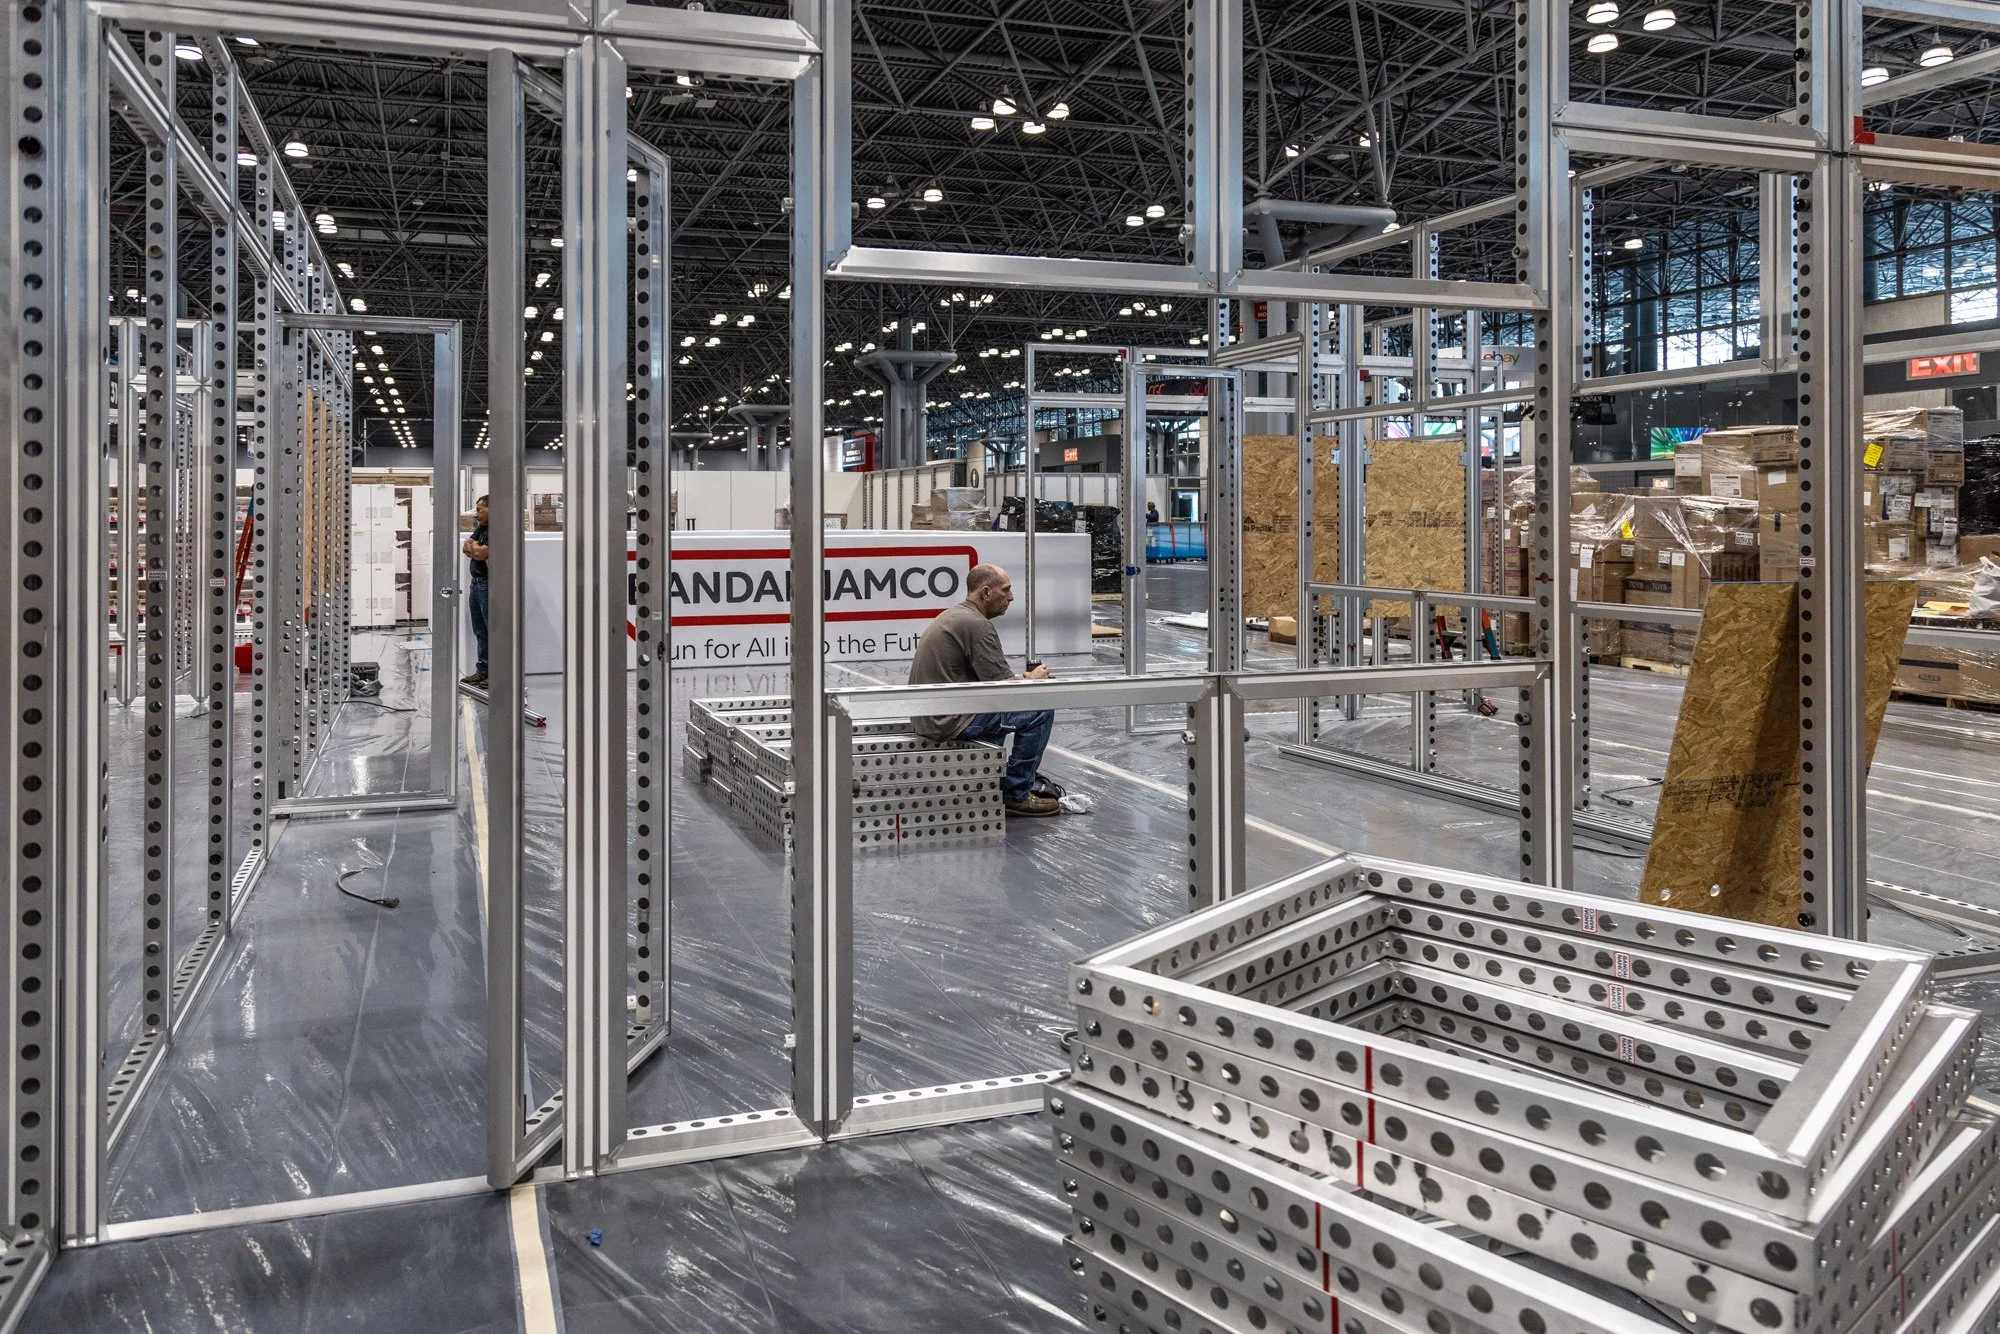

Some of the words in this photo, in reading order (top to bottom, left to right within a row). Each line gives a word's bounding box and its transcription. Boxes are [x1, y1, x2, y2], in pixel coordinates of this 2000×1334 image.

[629, 570, 791, 606] ANDAI
[671, 644, 696, 660] un
[704, 638, 740, 659] for
[746, 637, 776, 658] All
[837, 633, 876, 654] the
[884, 632, 921, 652] Fut
